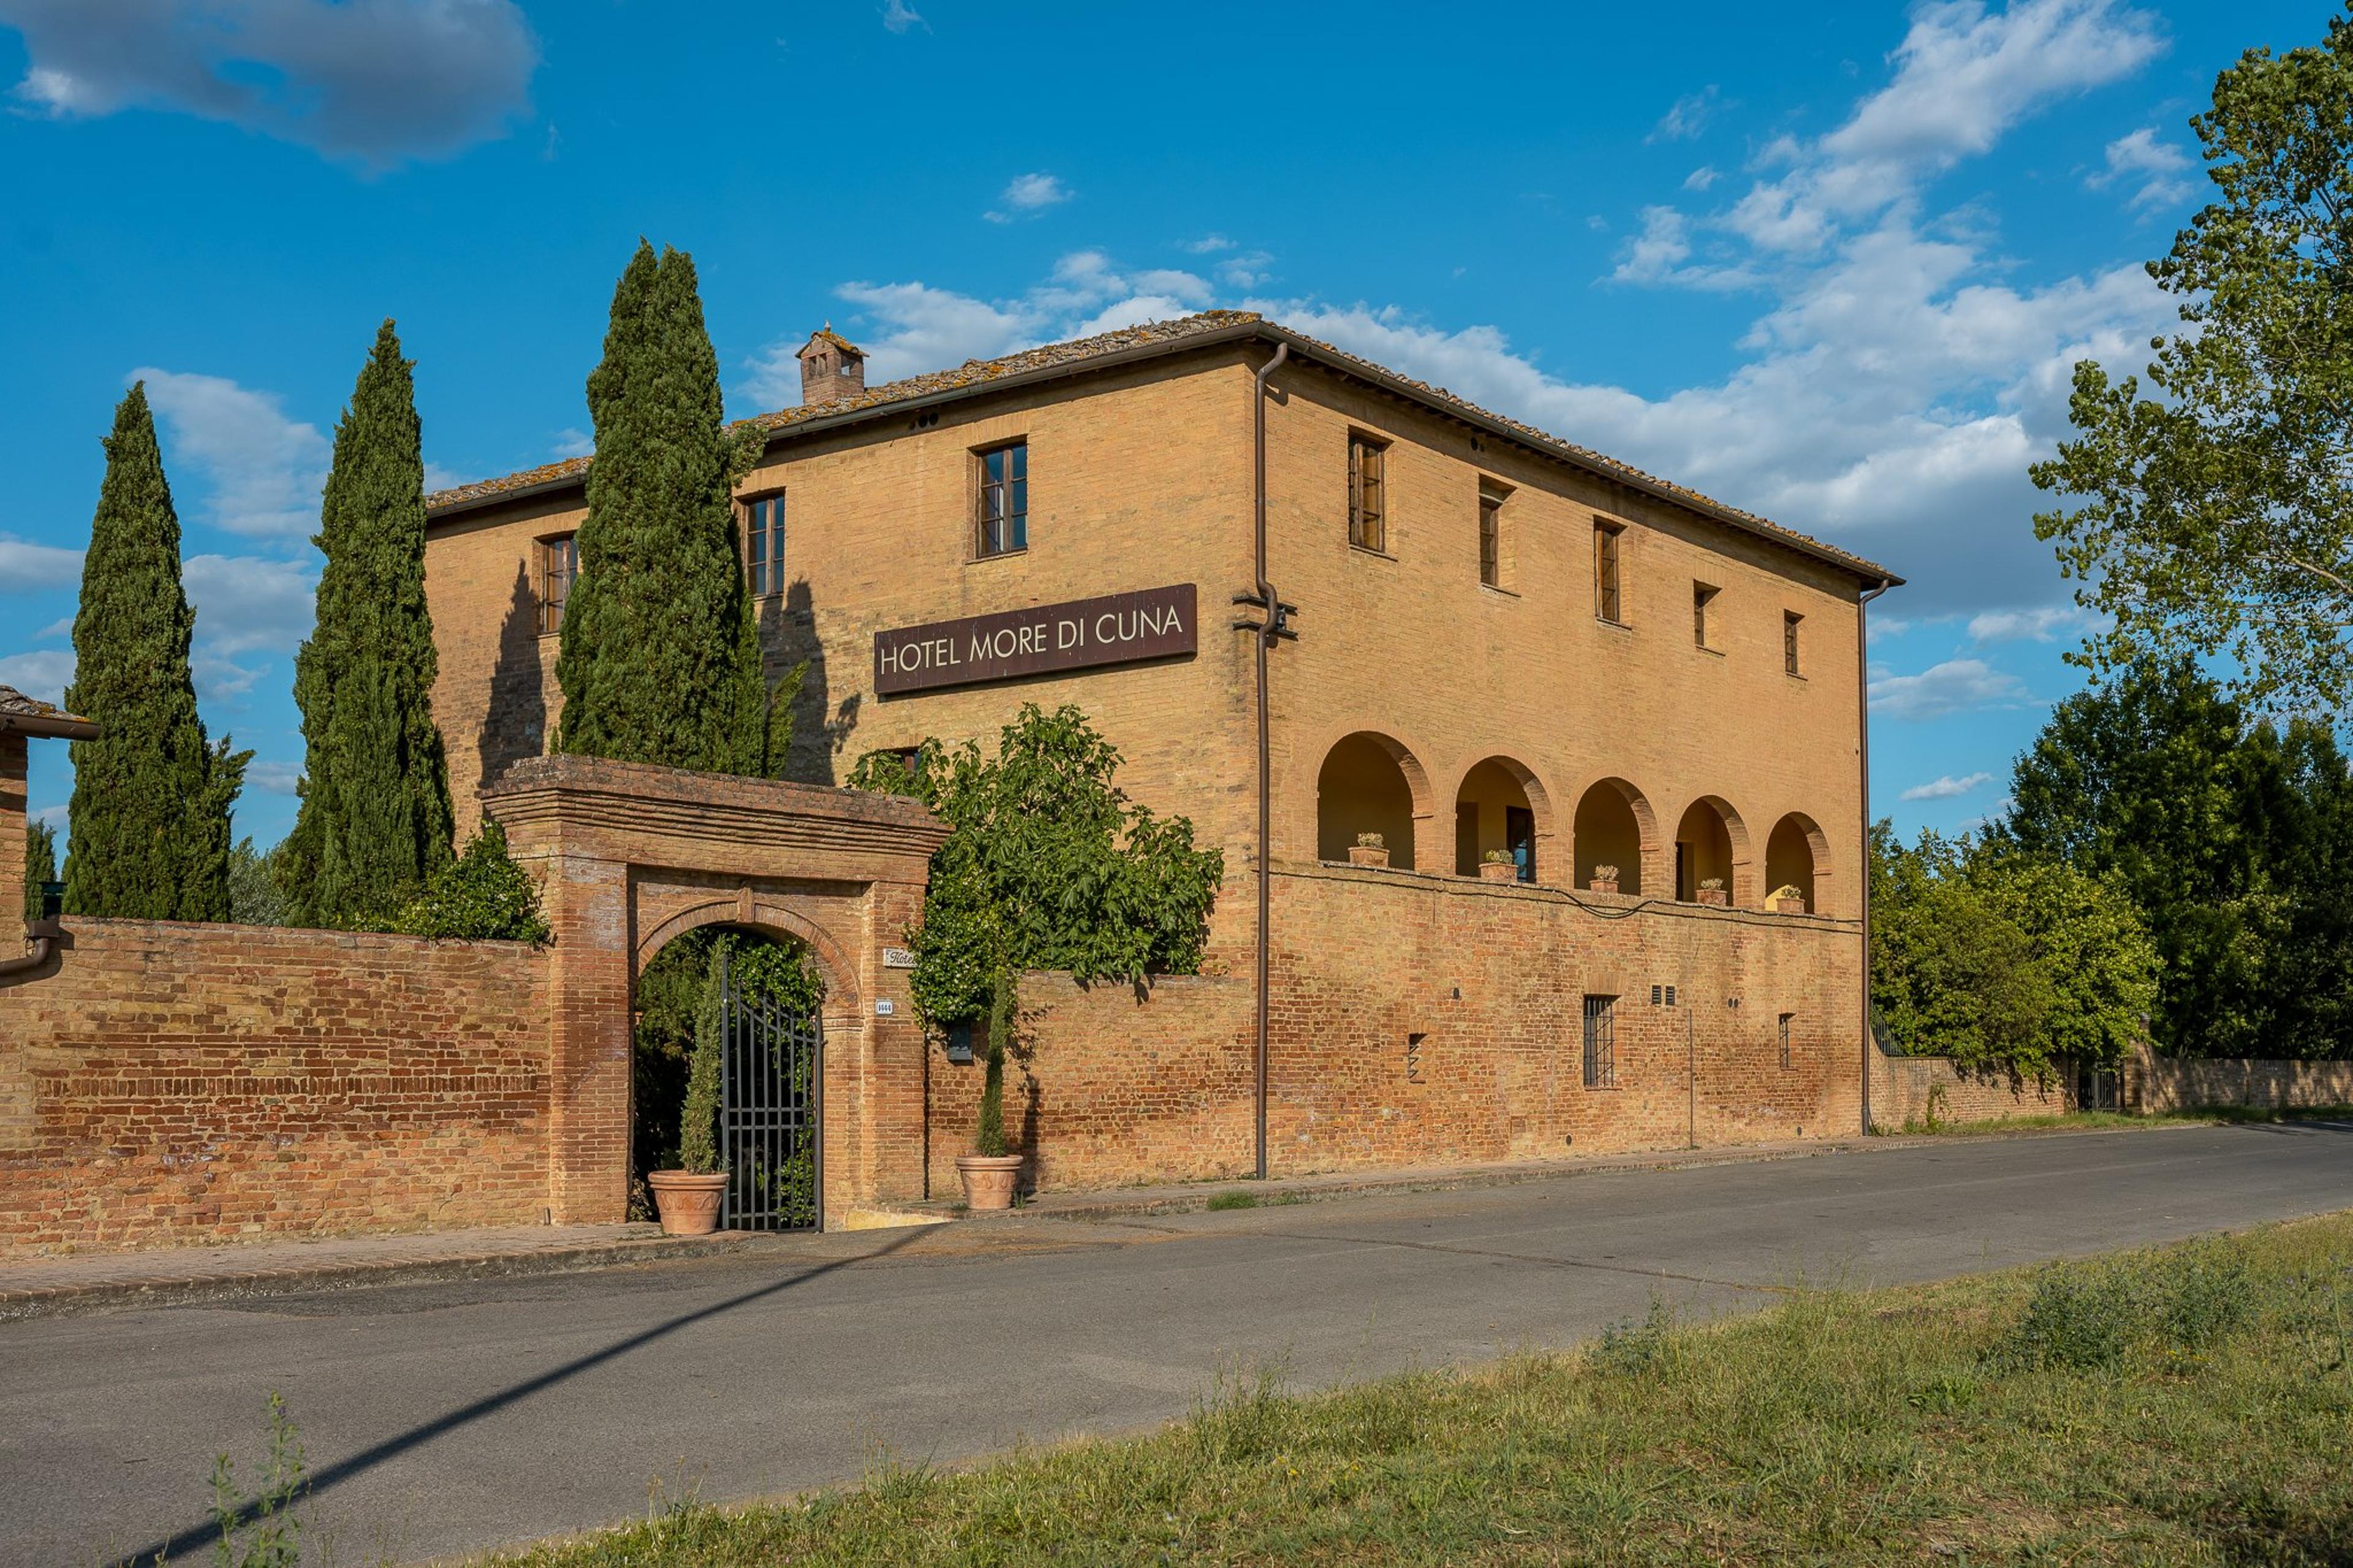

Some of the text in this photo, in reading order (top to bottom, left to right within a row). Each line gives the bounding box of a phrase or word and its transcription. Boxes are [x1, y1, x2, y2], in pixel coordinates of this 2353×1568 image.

[881, 605, 1183, 675] HOTEL MORE DI CUNA
